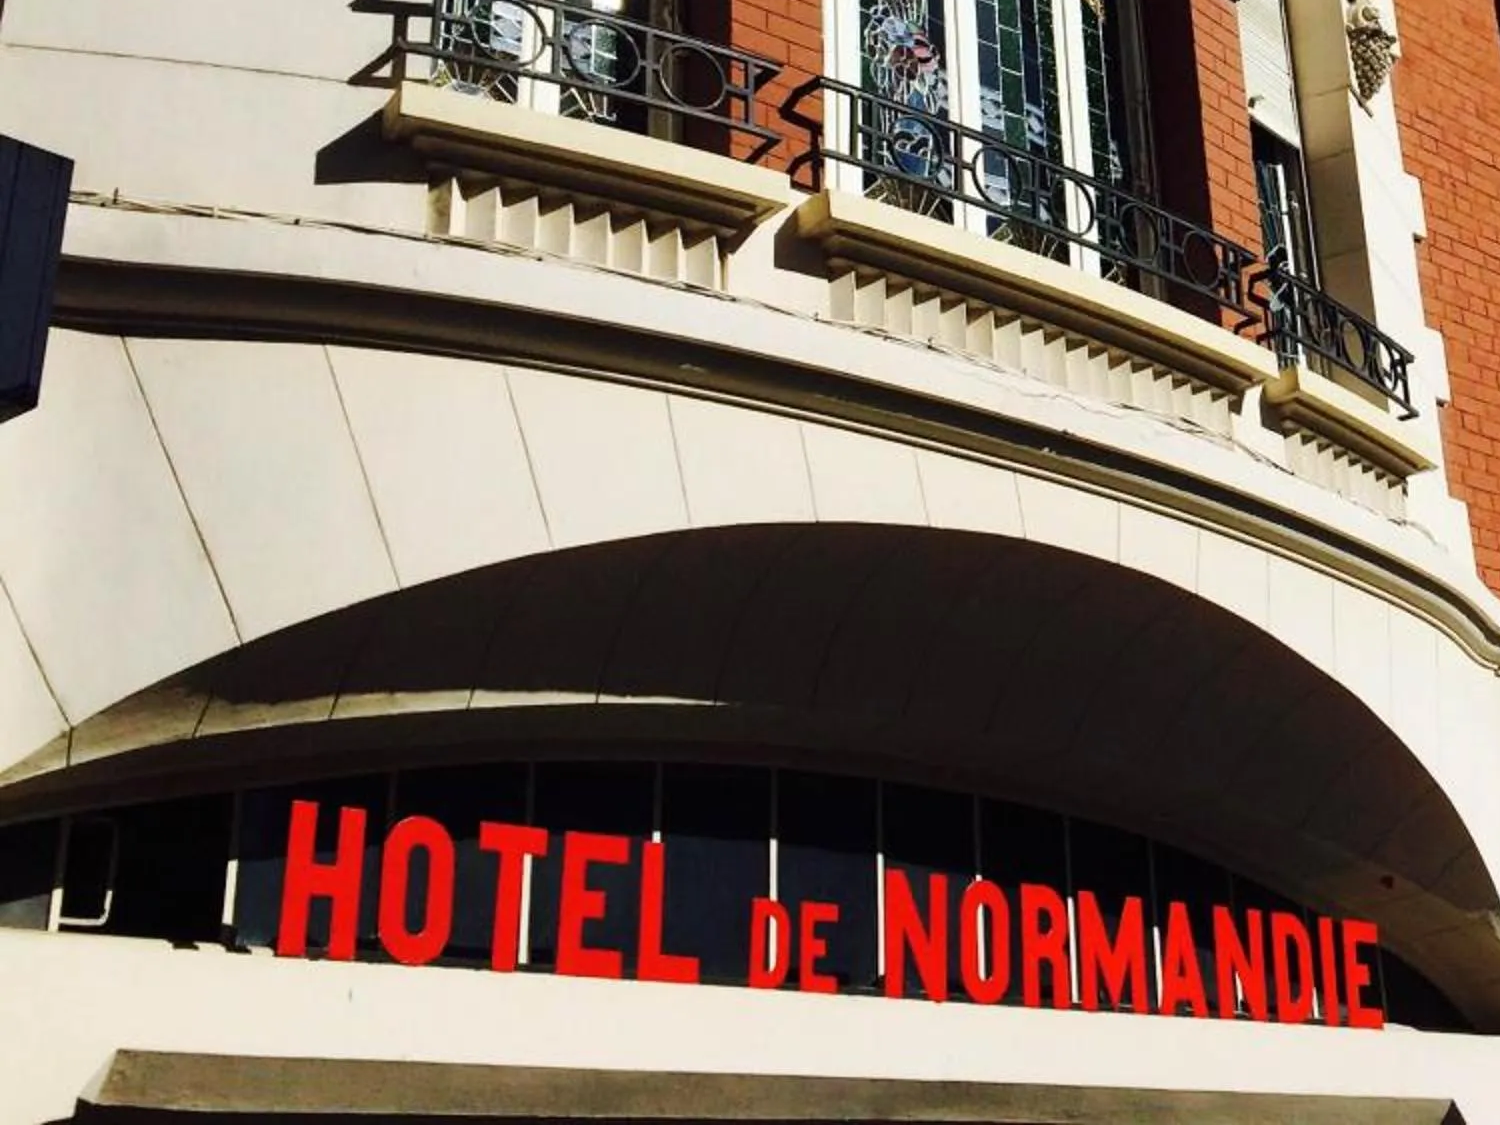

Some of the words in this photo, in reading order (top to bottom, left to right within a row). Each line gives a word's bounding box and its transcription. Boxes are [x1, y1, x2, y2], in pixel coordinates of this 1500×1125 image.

[276, 799, 700, 985] HOTEL
[748, 897, 840, 996] DE
[882, 868, 1387, 1031] NORMANDIE
